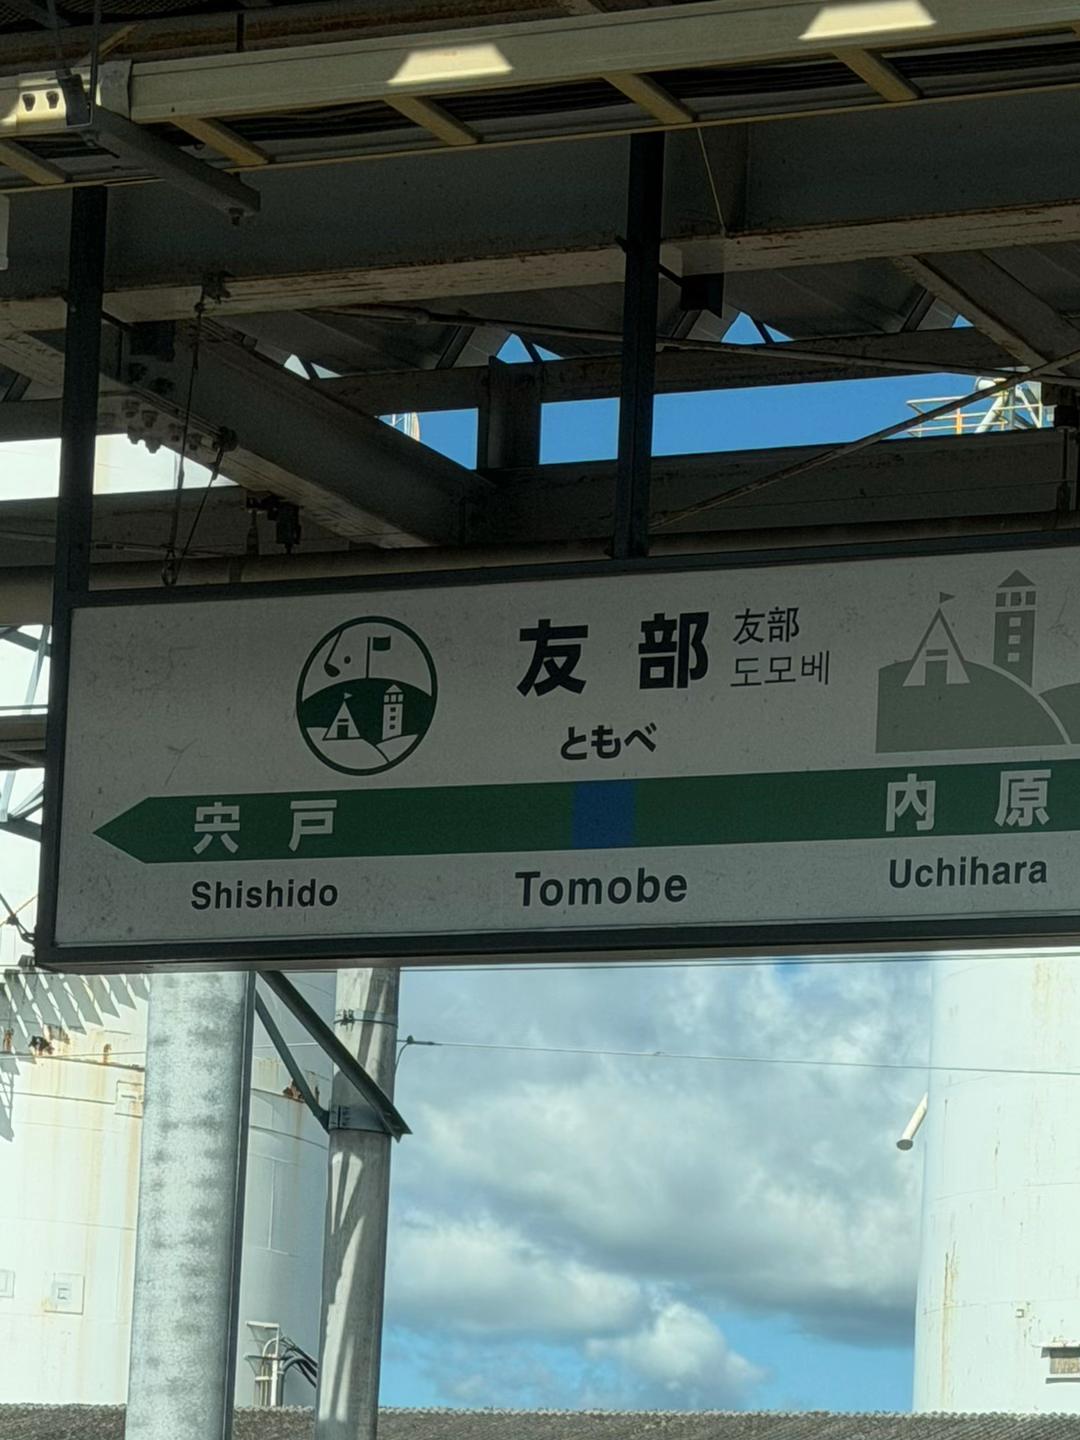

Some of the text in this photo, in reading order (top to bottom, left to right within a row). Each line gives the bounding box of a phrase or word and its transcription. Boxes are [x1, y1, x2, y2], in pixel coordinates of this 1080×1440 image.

[732, 606, 801, 646] 友部
[516, 610, 710, 697] 友部
[729, 649, 831, 688] 도모베
[559, 722, 658, 760] ともべ
[884, 767, 1053, 833] 内原
[191, 798, 339, 855] 宍戸
[513, 866, 688, 907] Tomobe
[887, 855, 1049, 890] Uchihara
[190, 877, 339, 910] Shishido
